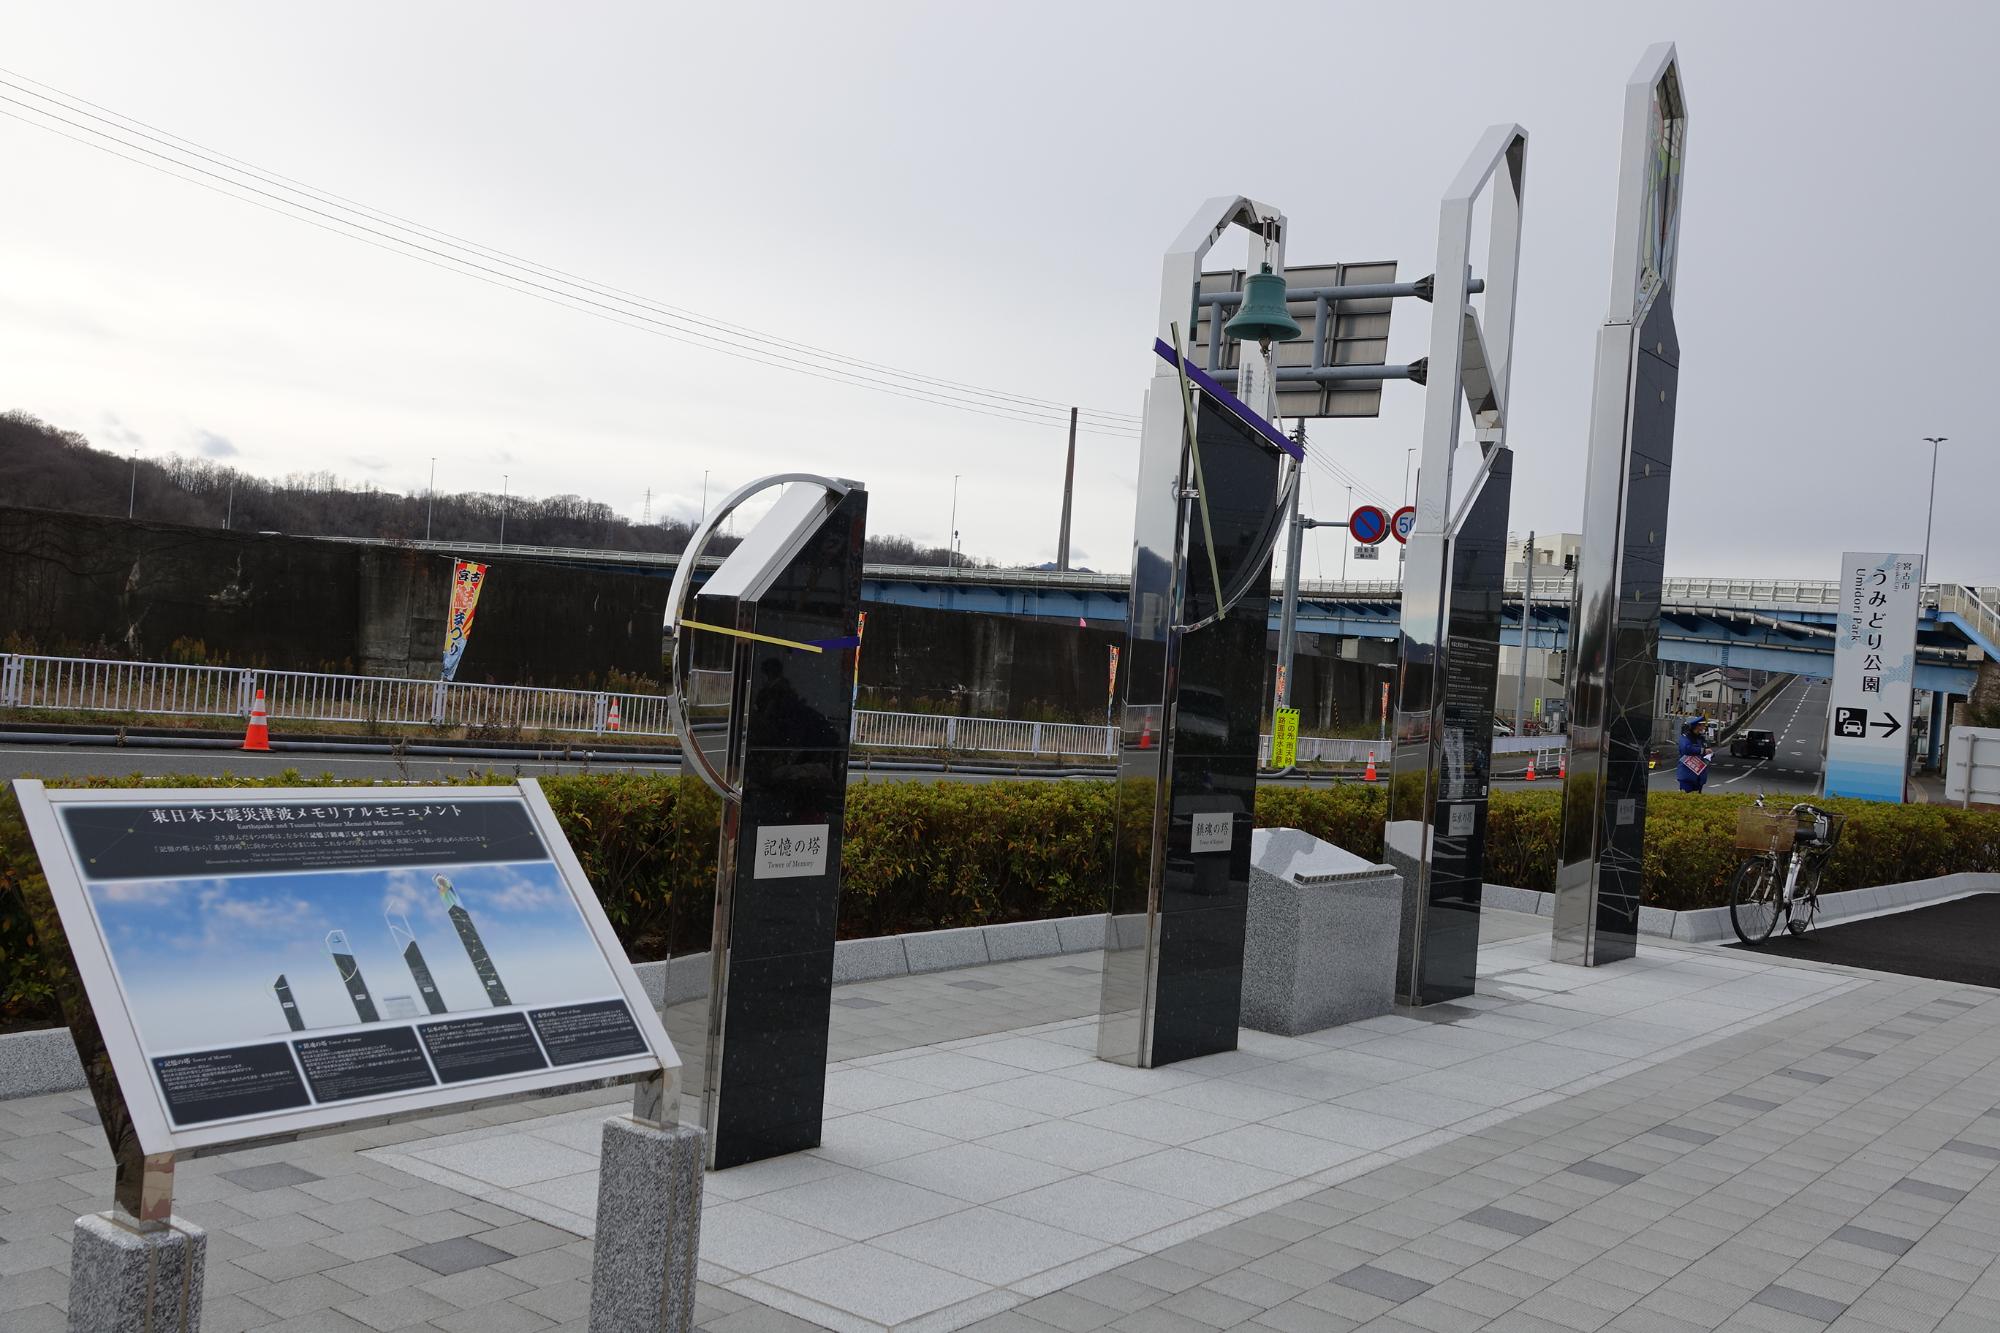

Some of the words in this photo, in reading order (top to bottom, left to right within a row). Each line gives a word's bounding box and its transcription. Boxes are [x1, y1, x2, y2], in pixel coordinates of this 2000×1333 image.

[459, 569, 481, 582] 宮古
[1901, 562, 1912, 590] 宮古市
[1853, 568, 1866, 613] Umidori
[1851, 618, 1862, 641] Park
[1863, 568, 1887, 693] うみどり公園
[1839, 709, 1850, 722] P
[151, 804, 462, 824] 東日本大震災津波メモリアルモニュメント
[236, 822, 274, 831] Earthquake
[343, 820, 372, 828] Memorial
[373, 819, 404, 827] Monument
[764, 836, 821, 857] 記憶の塔
[792, 860, 814, 869] Memory
